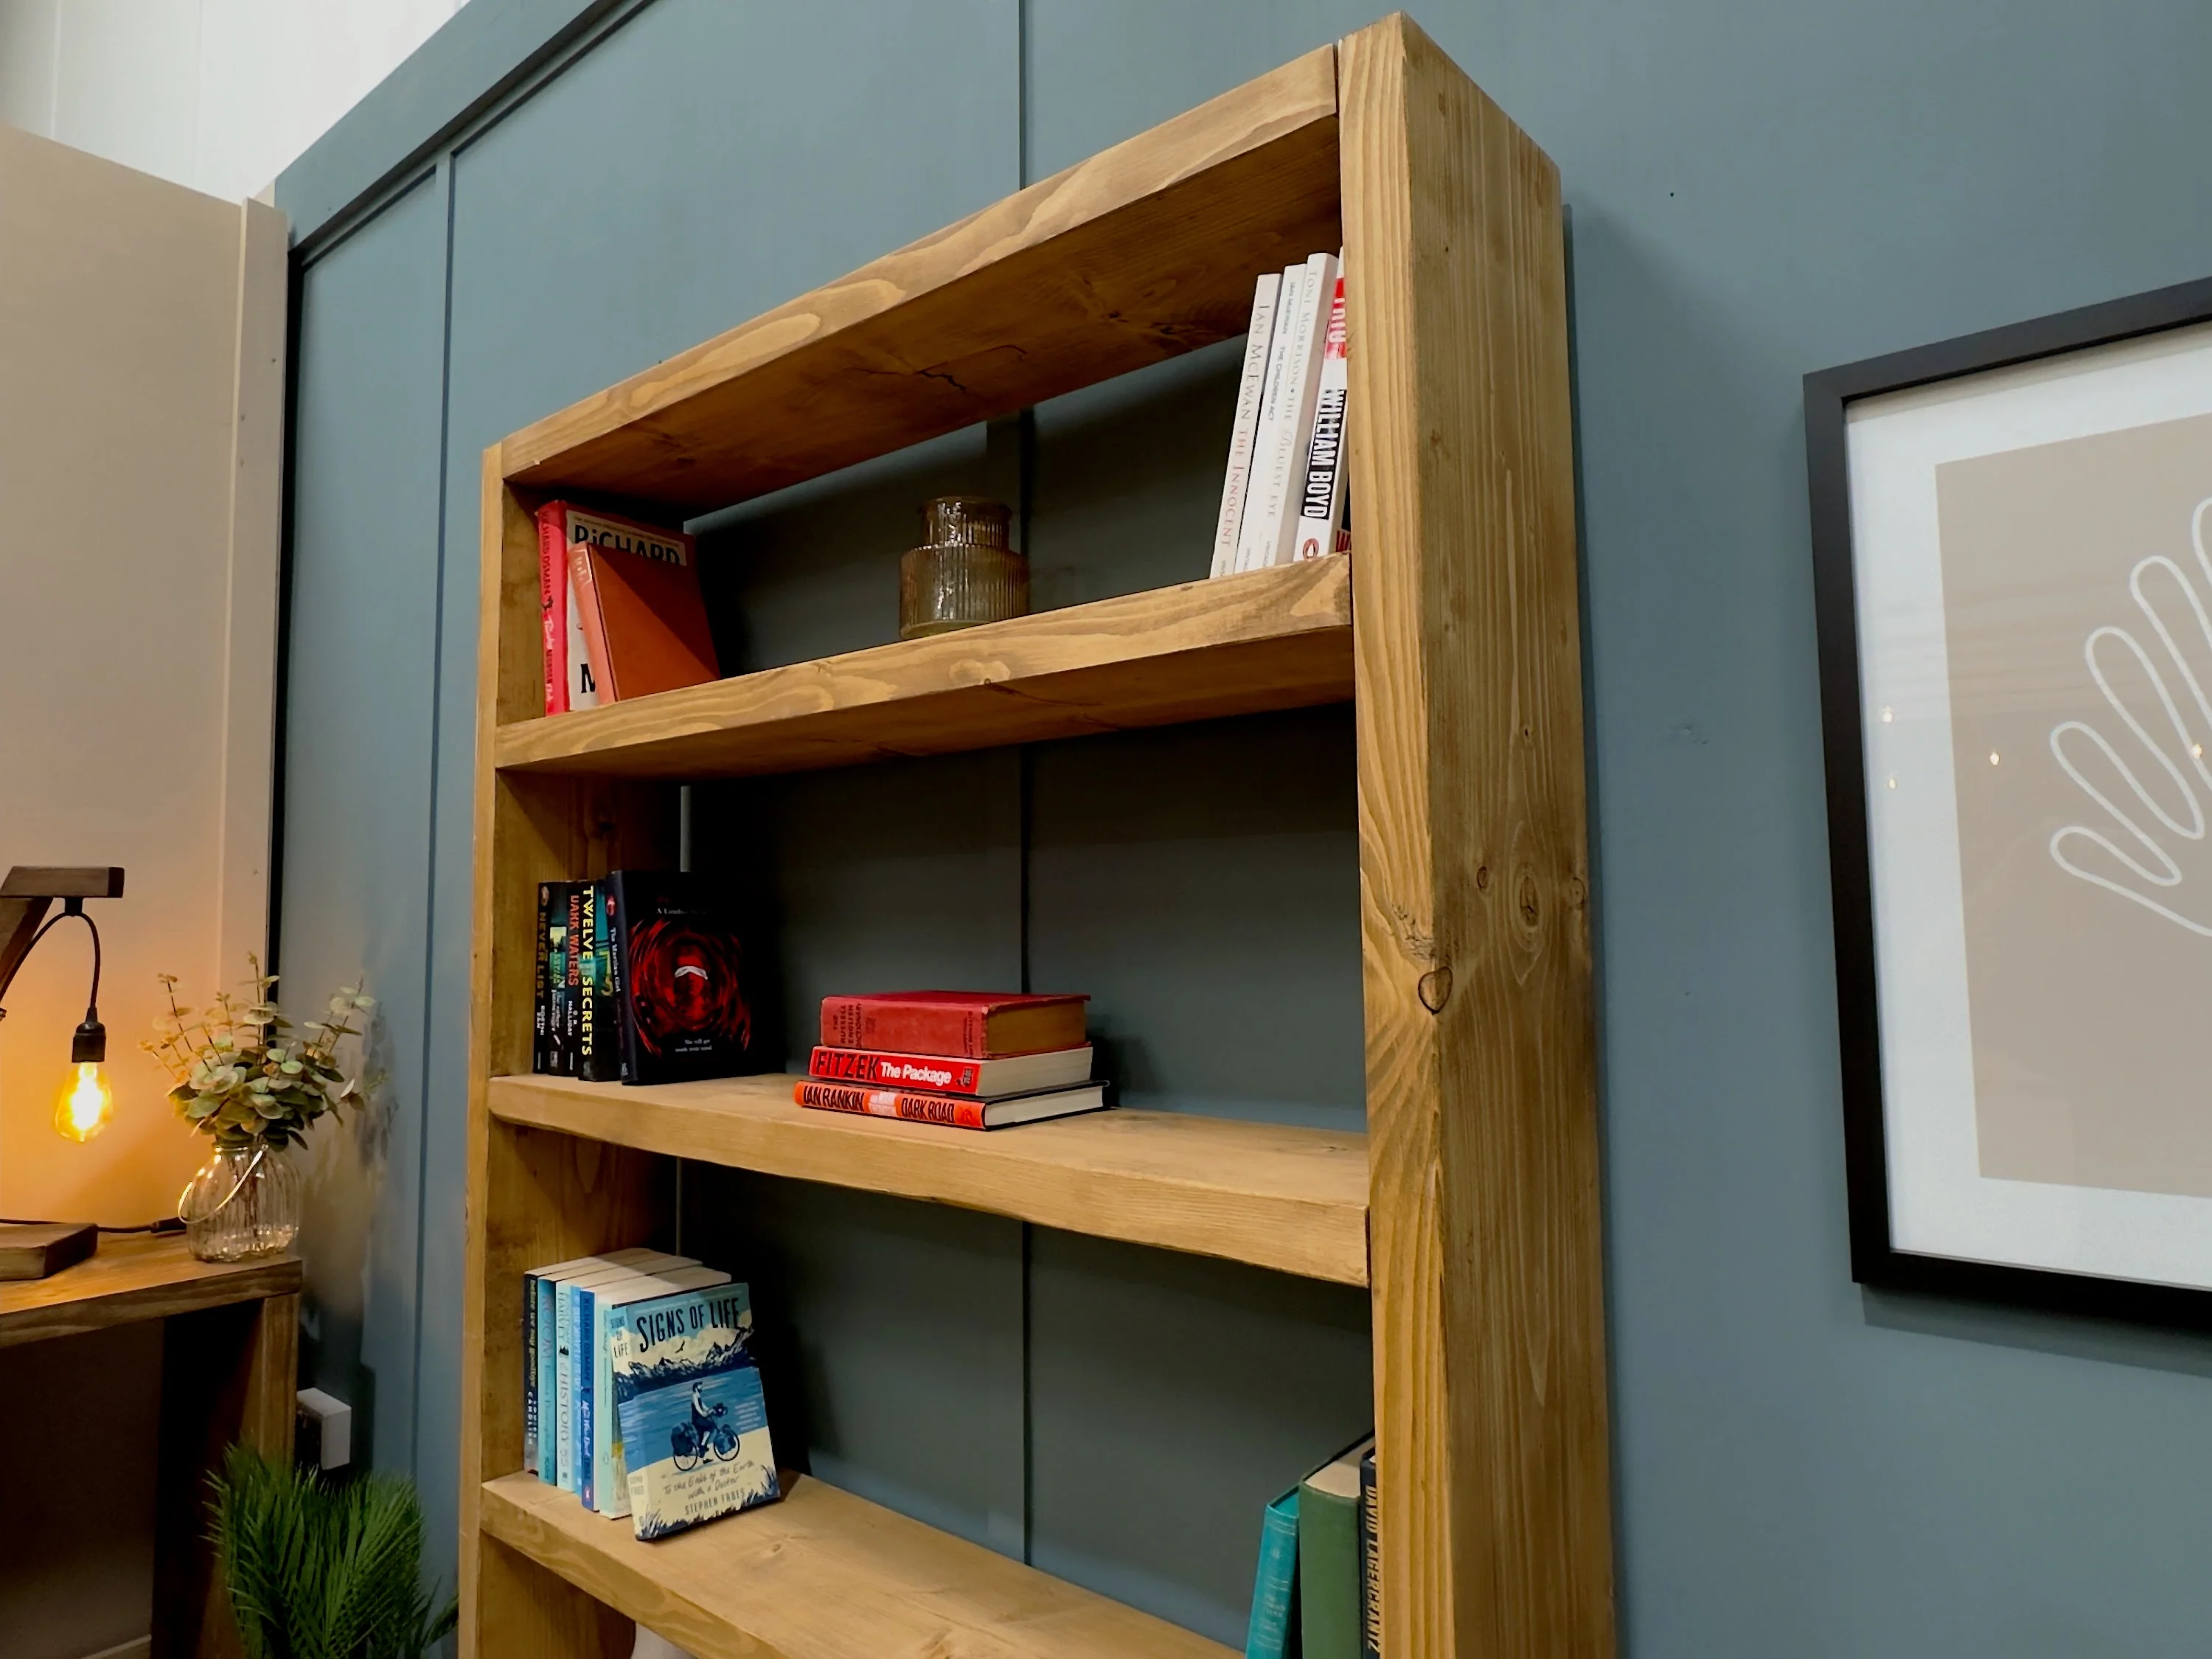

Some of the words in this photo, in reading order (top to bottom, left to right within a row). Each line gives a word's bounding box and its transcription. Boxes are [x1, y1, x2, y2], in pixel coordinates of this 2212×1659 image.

[1304, 271, 1317, 303] TONI
[1255, 305, 1270, 333] IAN
[1290, 312, 1310, 385] MORRISON
[1271, 364, 1282, 403] CHILDREN
[1284, 398, 1294, 420] THE
[1312, 389, 1346, 466] WILLIAM
[1235, 428, 1248, 457] THE
[1273, 428, 1293, 487] BLUEST
[1222, 466, 1245, 547] INNOCENT
[1268, 495, 1278, 517] EYE
[1304, 471, 1333, 518] BOYD
[582, 886, 594, 960] TWELVE
[568, 934, 579, 986] WATERS
[582, 977, 593, 1055] SECRETS
[816, 1051, 880, 1081] FITZEK
[881, 1062, 901, 1078] The
[902, 1065, 952, 1086] Package
[803, 1085, 822, 1106] IAN
[823, 1088, 865, 1112] RANKIN
[902, 1097, 928, 1119] DARK
[928, 1101, 955, 1124] ROAD
[636, 1308, 685, 1353] SIGNS
[689, 1304, 705, 1330] OF
[709, 1297, 740, 1329] LIFE
[613, 1342, 628, 1358] LIFE
[560, 1372, 569, 1443] HISTORY
[674, 1482, 686, 1492] the
[687, 1487, 706, 1500] with
[684, 1497, 718, 1515] STEPHEN
[1365, 1485, 1377, 1531] DAVID
